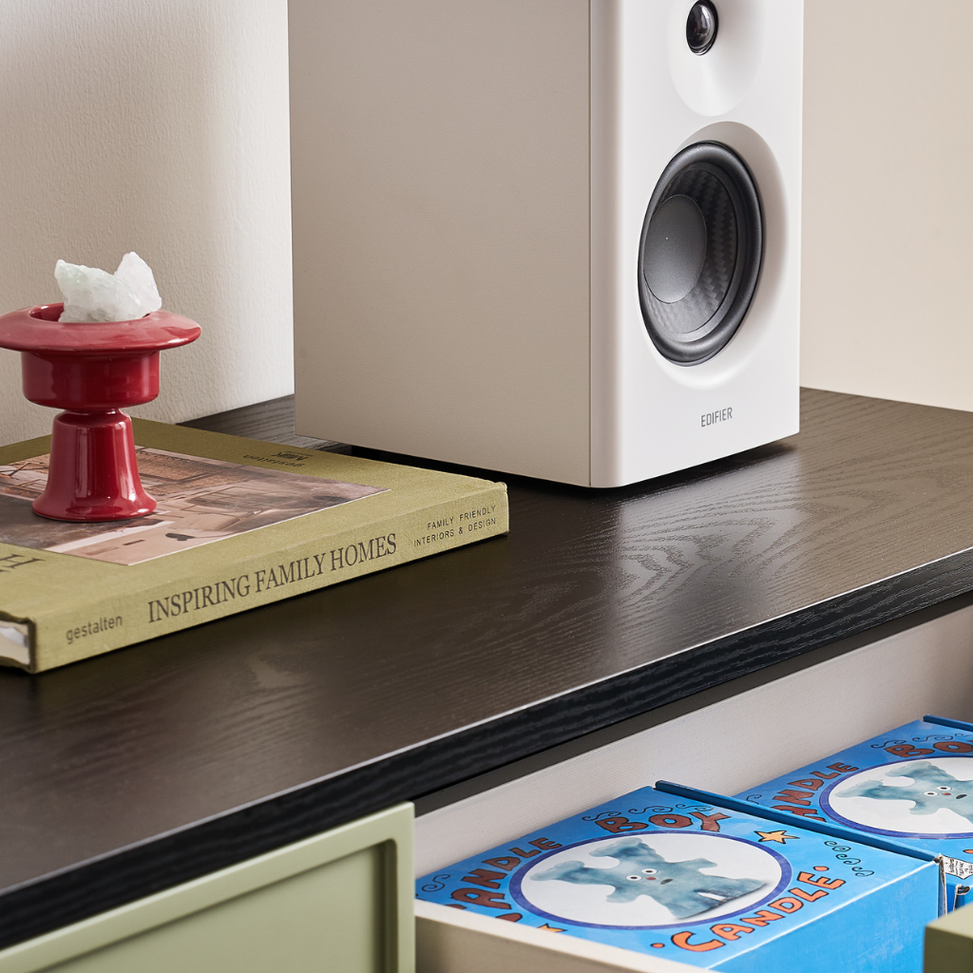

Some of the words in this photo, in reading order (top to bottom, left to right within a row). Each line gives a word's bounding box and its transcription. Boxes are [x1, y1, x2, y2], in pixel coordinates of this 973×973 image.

[700, 406, 733, 428] EDIFIER
[413, 528, 455, 548] INTERIORS
[458, 526, 463, 535] &
[467, 517, 496, 532] DESIGN
[427, 516, 454, 531] FAMILY
[459, 504, 496, 522] FRIENDLY
[65, 615, 123, 645] gestalten
[147, 574, 251, 623] INSPIRING
[254, 552, 327, 593] FAMILY
[330, 532, 398, 572] HOMES
[770, 762, 860, 823] ANDLE
[444, 836, 563, 923] ANDLE
[670, 870, 847, 953] CANDLE
